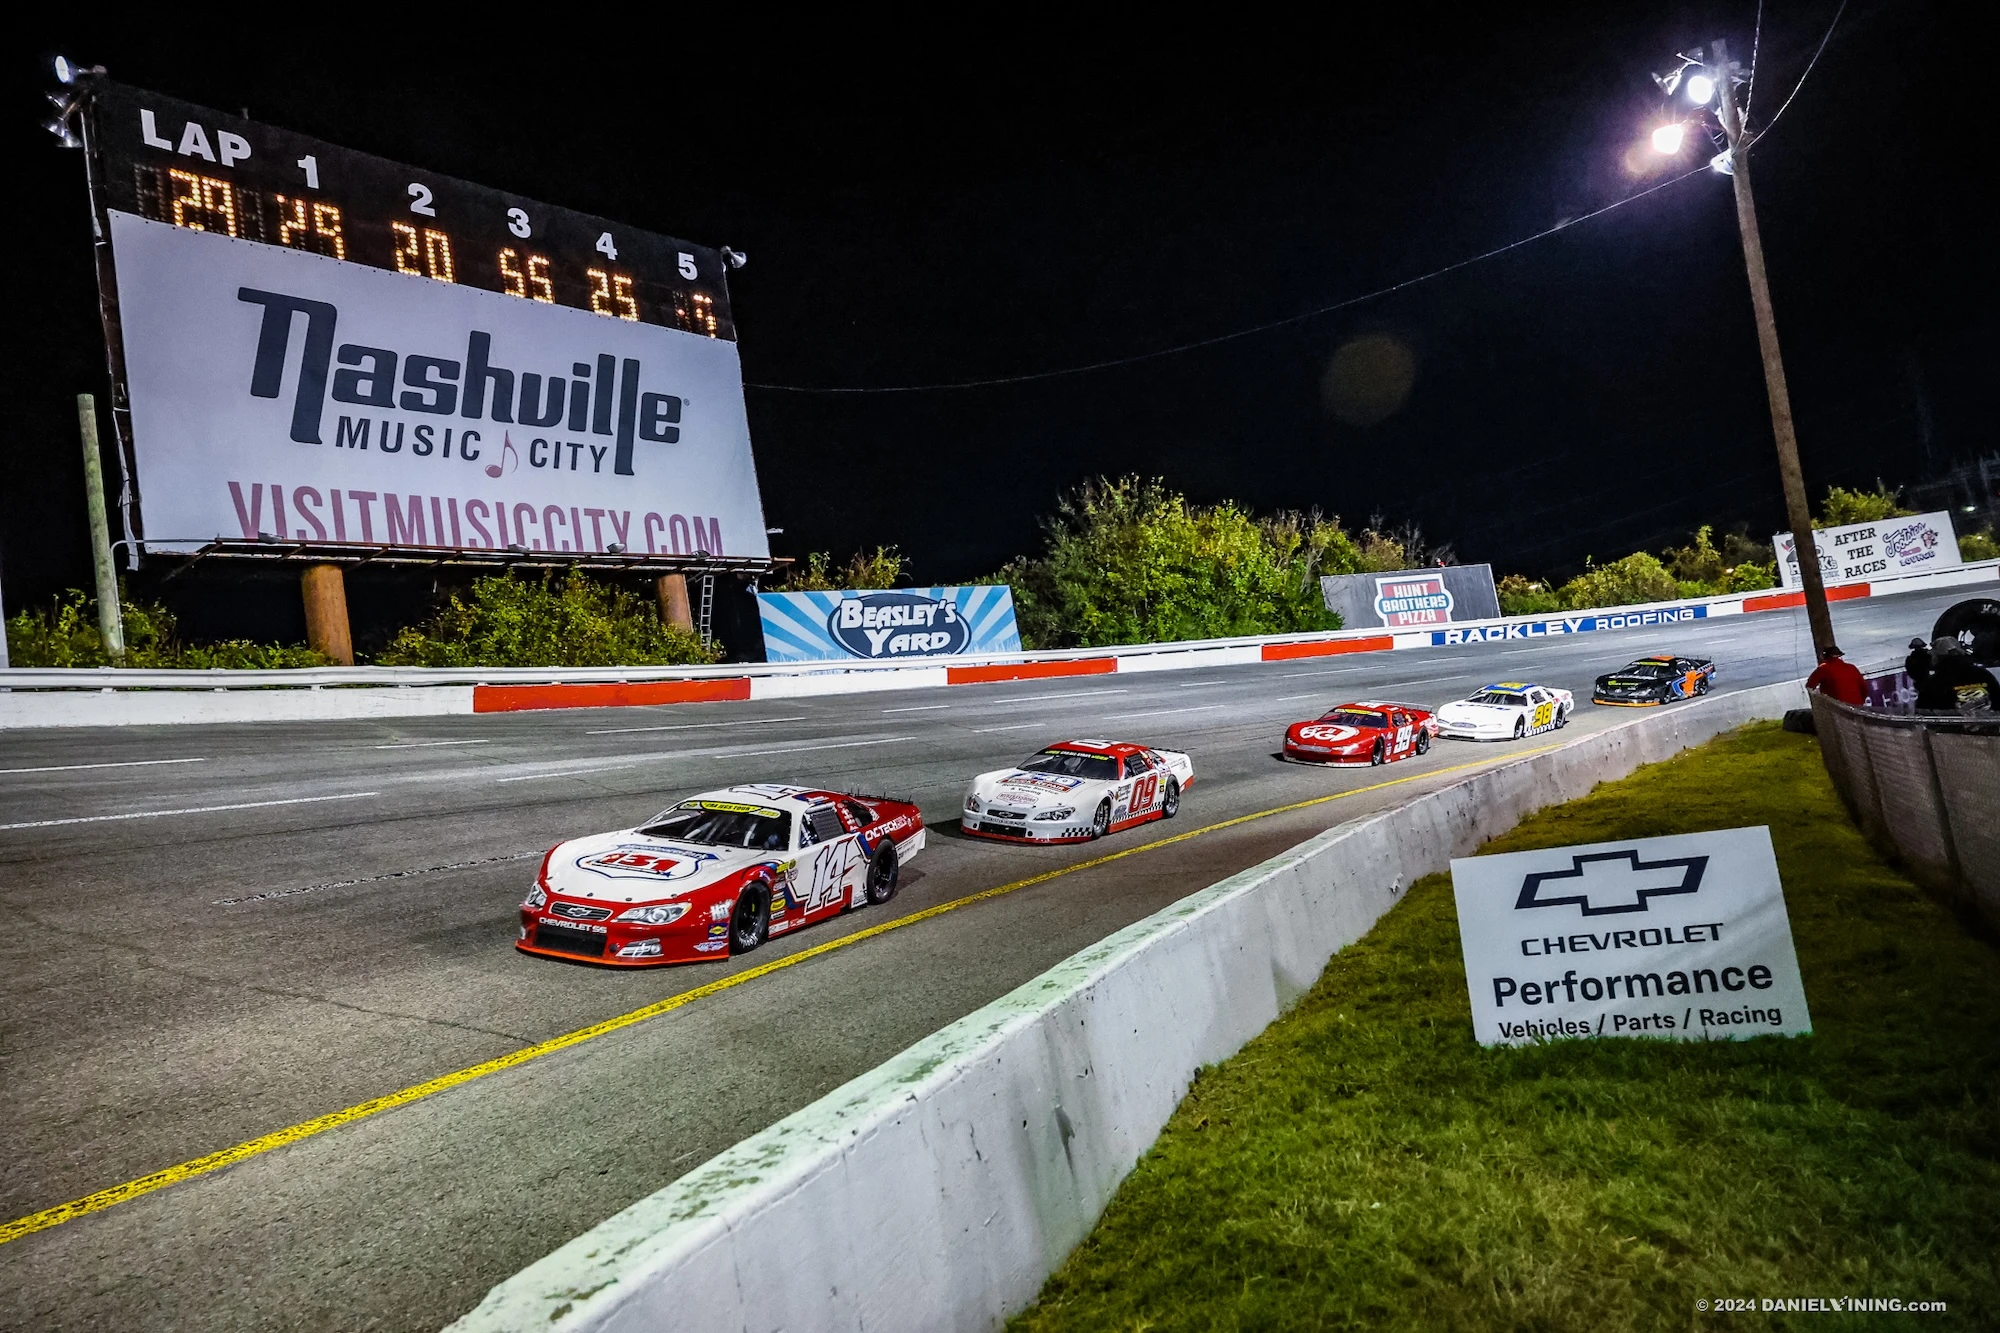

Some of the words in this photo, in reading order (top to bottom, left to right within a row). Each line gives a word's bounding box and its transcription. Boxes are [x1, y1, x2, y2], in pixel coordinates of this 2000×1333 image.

[140, 109, 251, 167] LAP
[297, 155, 319, 189] 1
[407, 183, 436, 217] 2
[507, 207, 532, 239] 3
[596, 232, 618, 260] 4
[677, 252, 698, 280] 5
[392, 220, 454, 284] 20
[499, 247, 554, 304] 55
[586, 267, 638, 322] 25
[335, 415, 481, 461] MUSIC
[529, 438, 608, 472] CITY
[1834, 527, 1877, 546] AFTER
[1847, 545, 1874, 561] THE
[1845, 559, 1887, 579] RACES
[1382, 596, 1447, 613] BROTHERS
[1393, 583, 1429, 598] HUNT
[1398, 609, 1436, 625] PIZZA
[1445, 618, 1584, 645] RACKLEY
[1595, 609, 1694, 630] ROOFING
[863, 629, 951, 657] YARD
[1533, 701, 1553, 728] 98
[1393, 724, 1413, 754] 99
[1128, 772, 1158, 813] 09
[804, 838, 862, 915] 14
[539, 917, 592, 932] CHEVROLET
[592, 926, 607, 934] SS
[1521, 923, 1724, 956] CHEVROLET
[1492, 964, 1773, 1007] Performance
[1499, 1015, 1590, 1039] Vehicles
[1613, 1012, 1676, 1031] Parts
[1700, 1005, 1783, 1026] Racing
